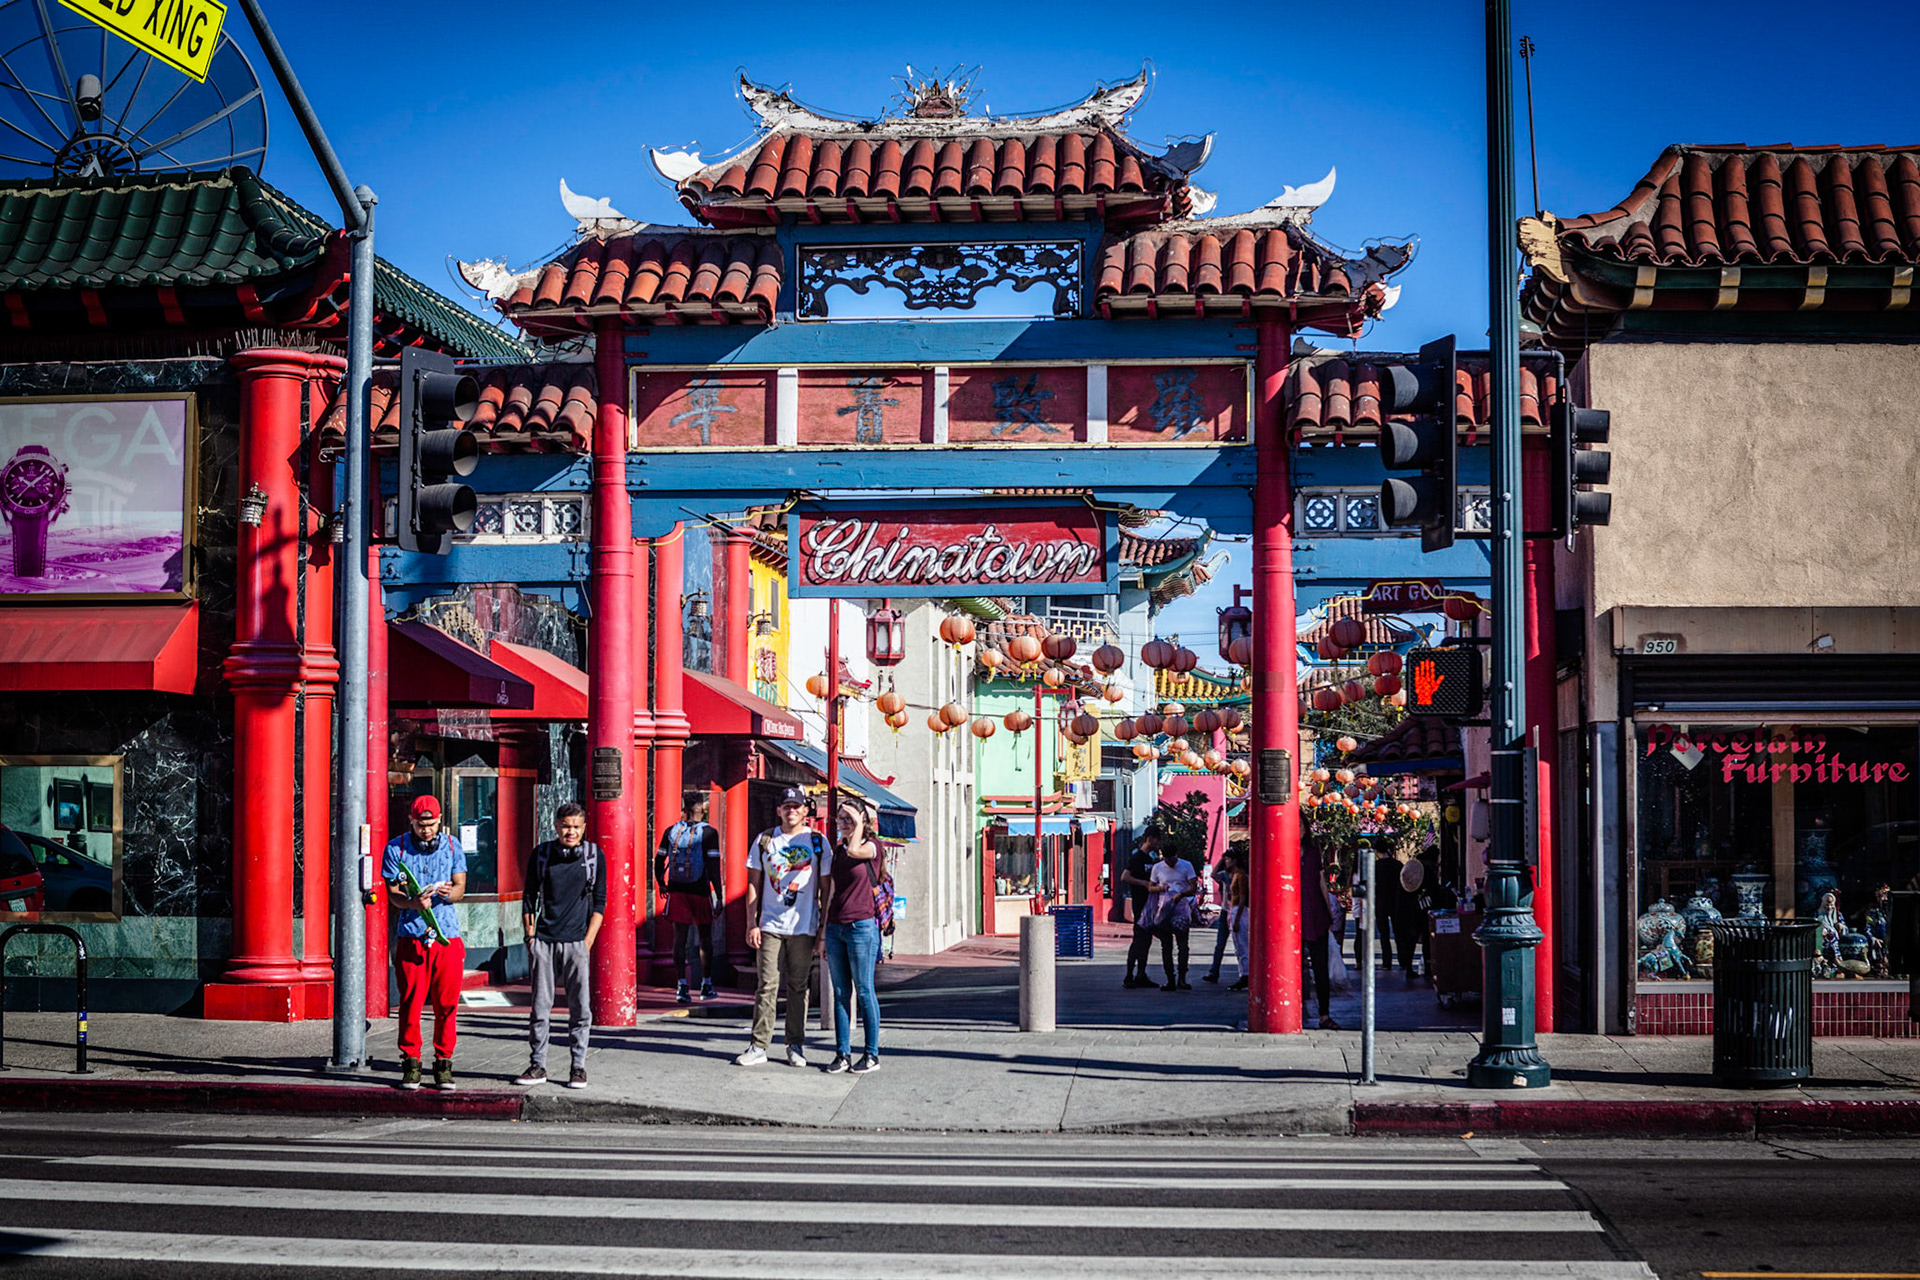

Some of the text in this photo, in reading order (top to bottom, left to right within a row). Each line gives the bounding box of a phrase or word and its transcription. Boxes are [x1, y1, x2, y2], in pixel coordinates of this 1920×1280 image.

[143, 0, 208, 58] XING
[803, 517, 1098, 583] Chinatown
[1371, 585, 1402, 601] ART
[1645, 641, 1675, 653] 950
[1646, 722, 1827, 757] Porcelain
[1721, 752, 1911, 783] Furniture
